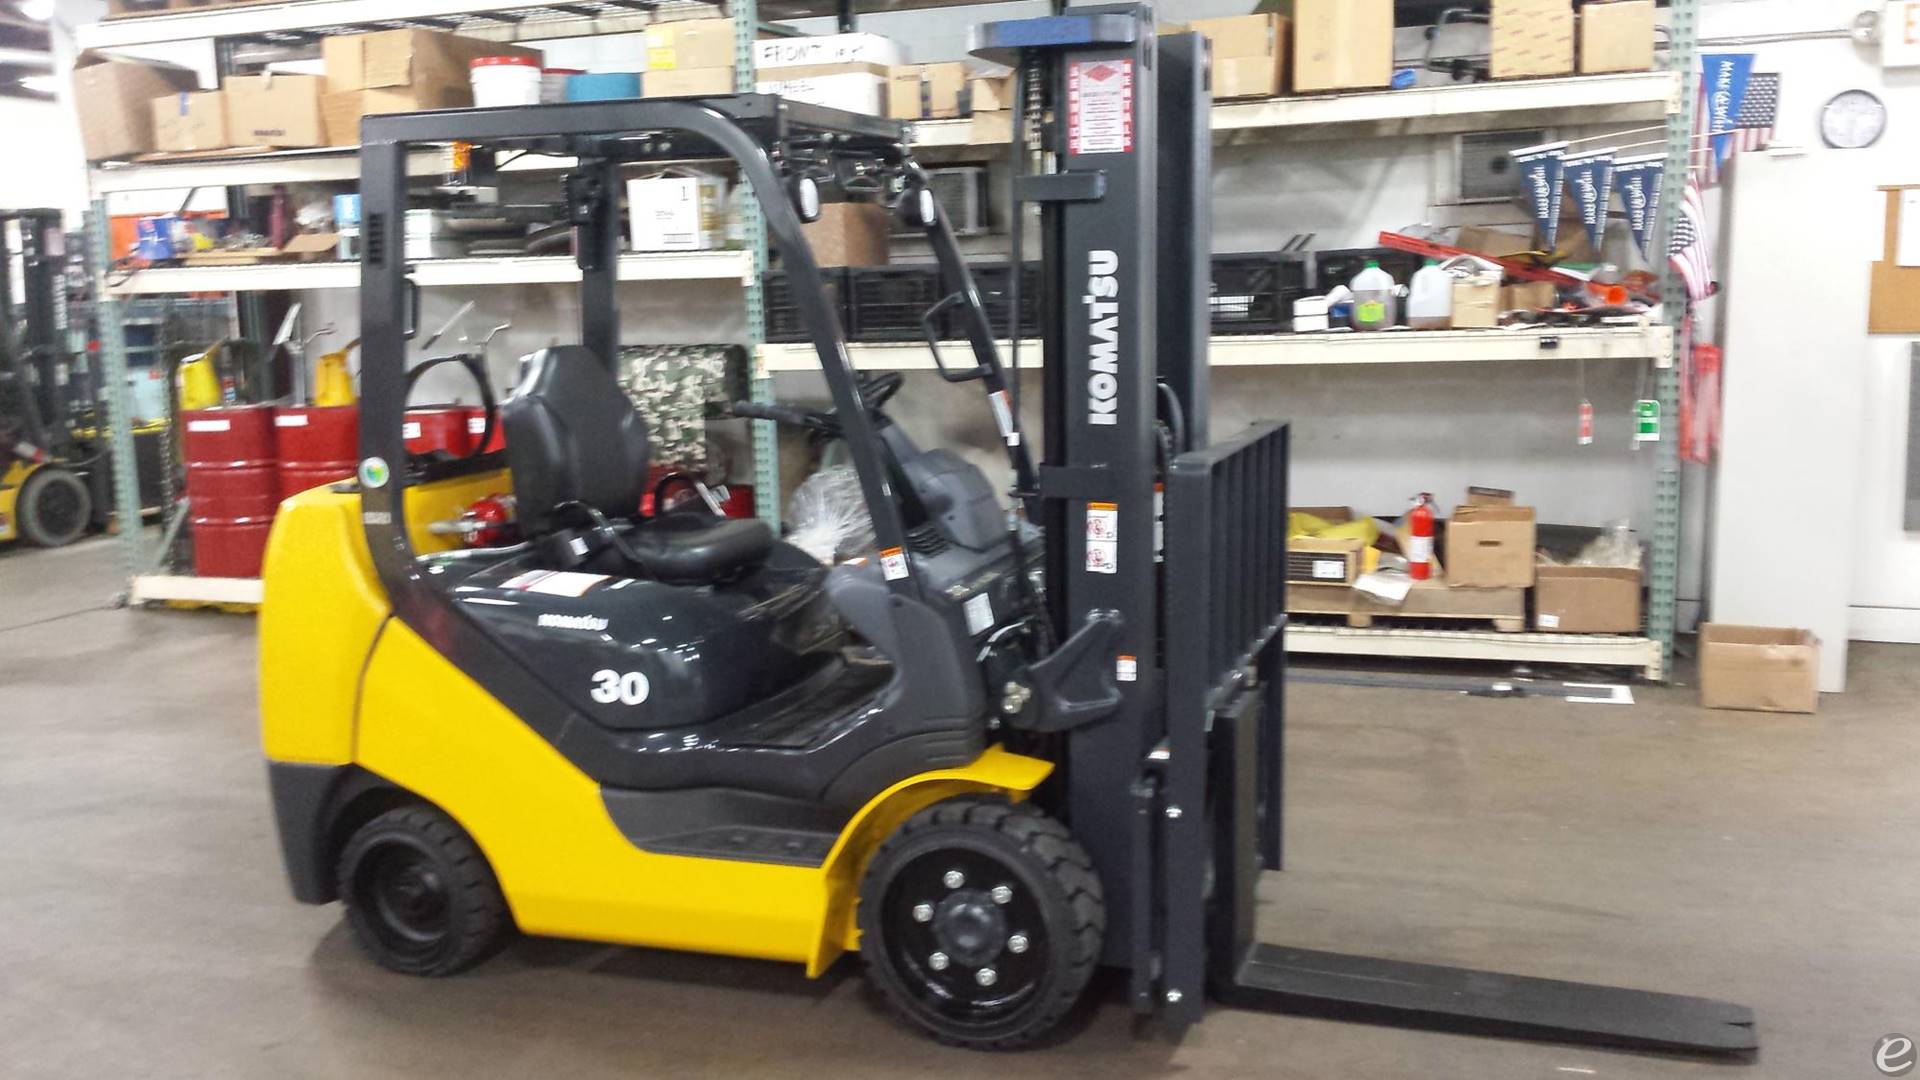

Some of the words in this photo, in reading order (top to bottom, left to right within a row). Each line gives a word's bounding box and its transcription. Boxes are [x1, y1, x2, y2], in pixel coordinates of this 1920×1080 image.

[764, 44, 822, 62] FRONT
[1083, 250, 1119, 425] KOMATSU
[590, 669, 650, 705] 30
